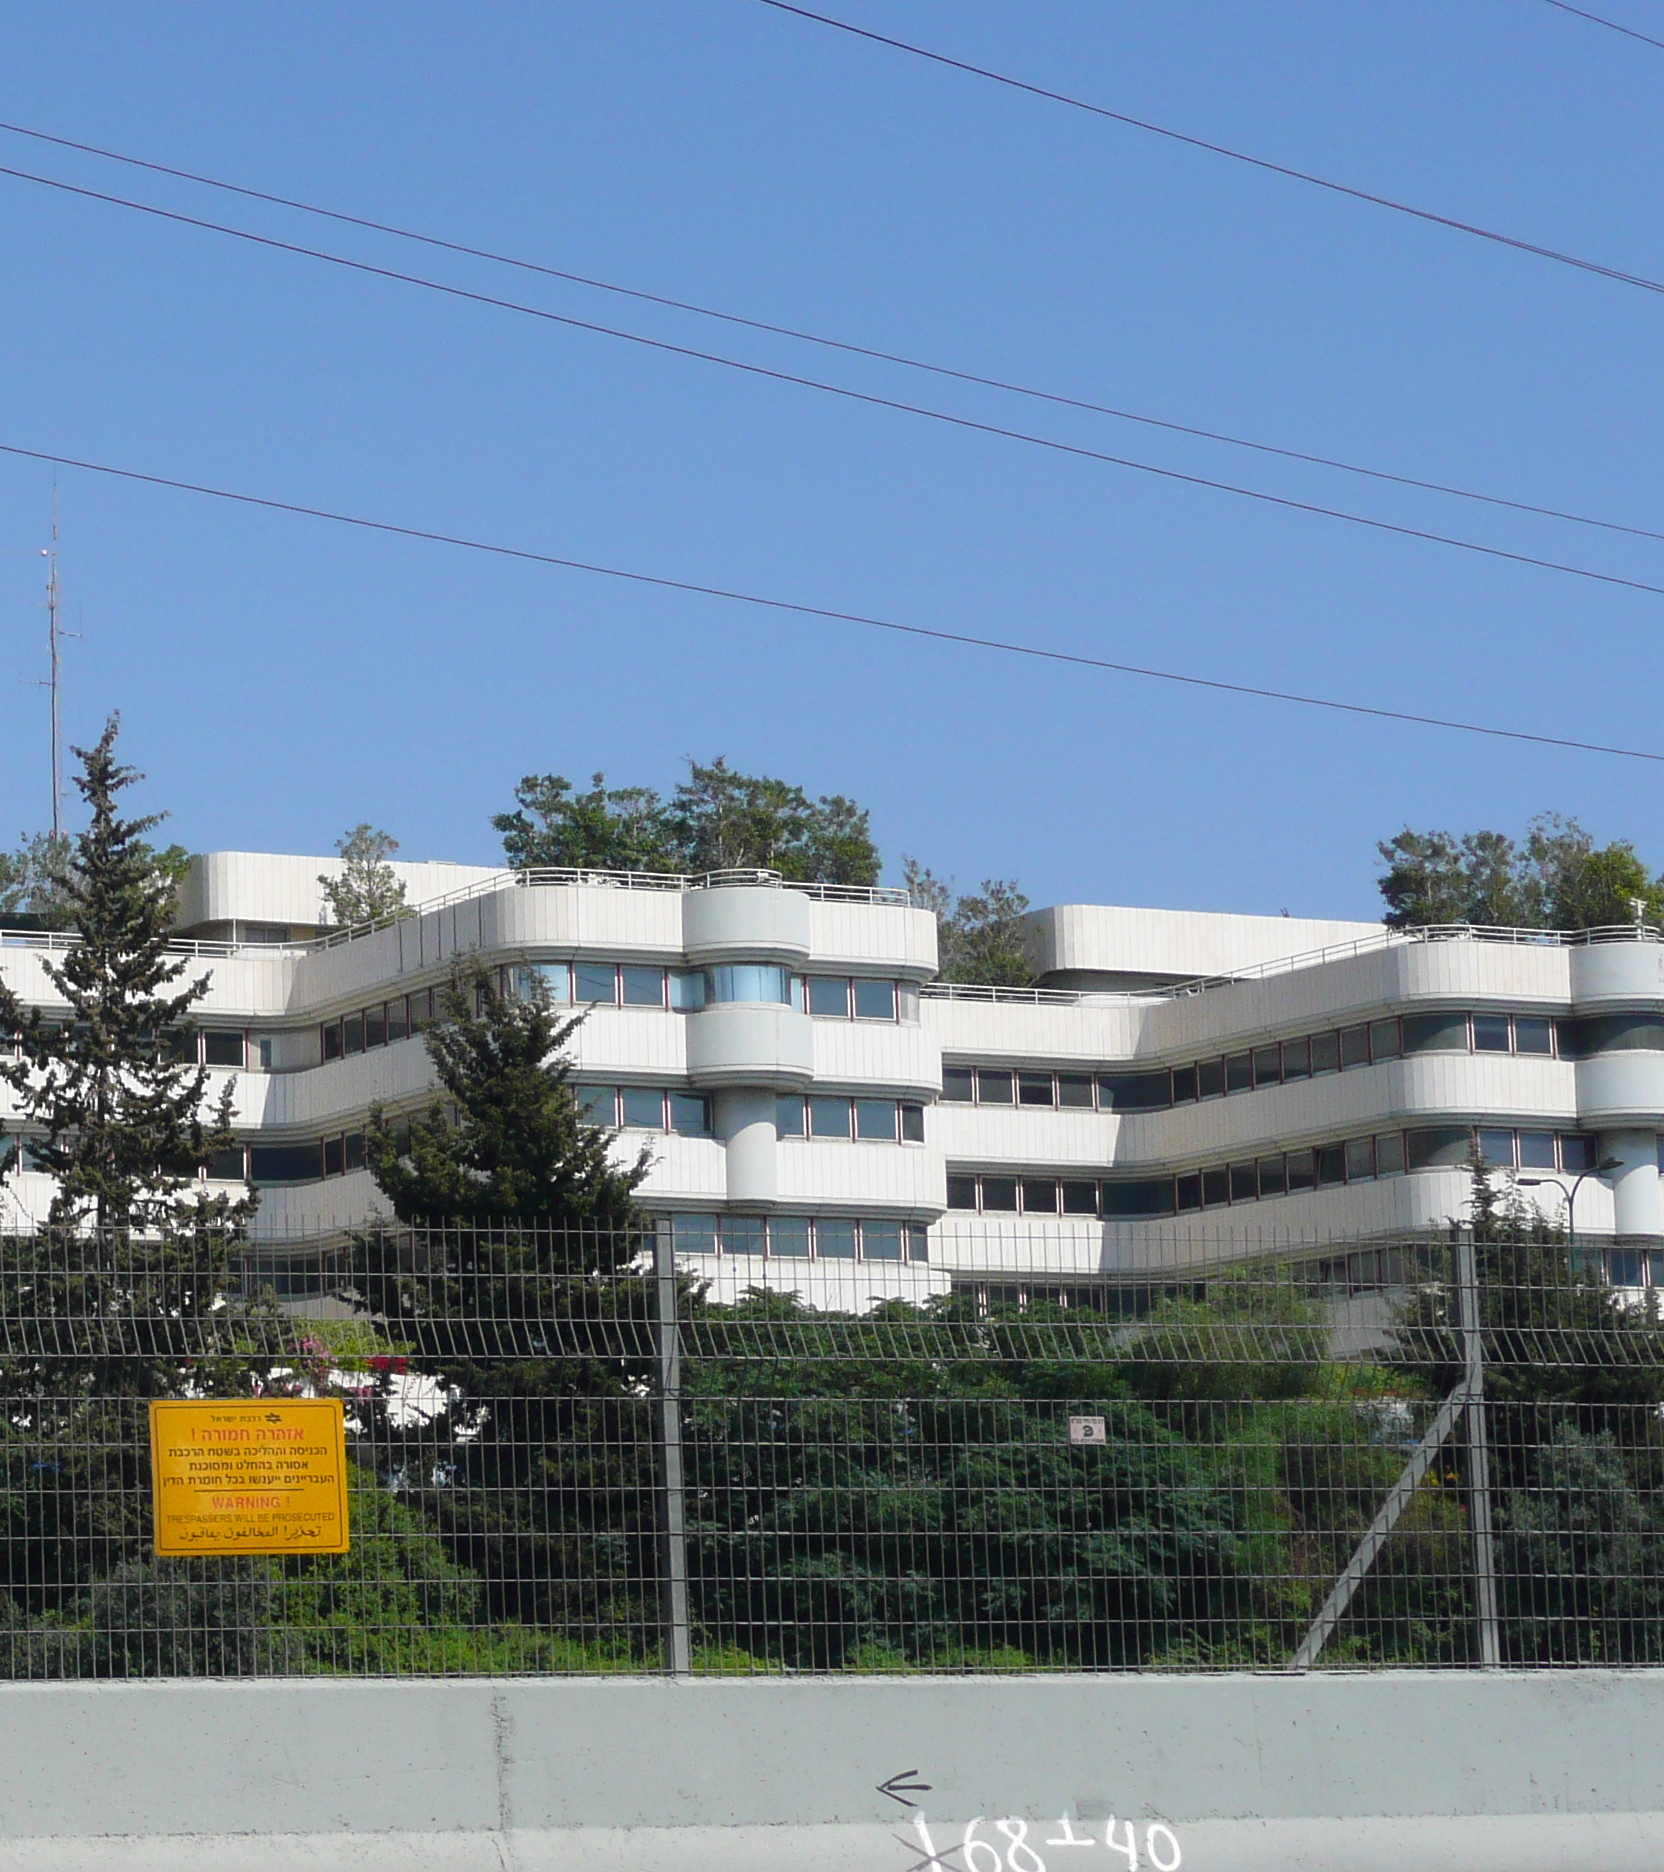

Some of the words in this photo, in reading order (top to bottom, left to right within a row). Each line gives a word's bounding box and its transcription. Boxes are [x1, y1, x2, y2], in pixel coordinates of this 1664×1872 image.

[210, 1414, 237, 1423] ישראל
[202, 1428, 250, 1442] חמורה
[256, 1428, 304, 1441] אזהרה
[168, 1447, 205, 1458] הרכבת
[208, 1447, 240, 1457] בשטח
[290, 1445, 328, 1456] הכניסה
[189, 1461, 233, 1471] ומסוכנת
[237, 1460, 273, 1471] בהחלט
[276, 1460, 310, 1470] אסורה
[163, 1476, 184, 1487] הדין
[188, 1475, 223, 1486] חומרת
[226, 1474, 245, 1485] בכל
[212, 1496, 281, 1509] WARNING
[166, 1514, 232, 1524] TRESPASSERS
[233, 1513, 255, 1523] WILL
[258, 1513, 270, 1523] BE
[272, 1512, 335, 1522] PROSECUTED
